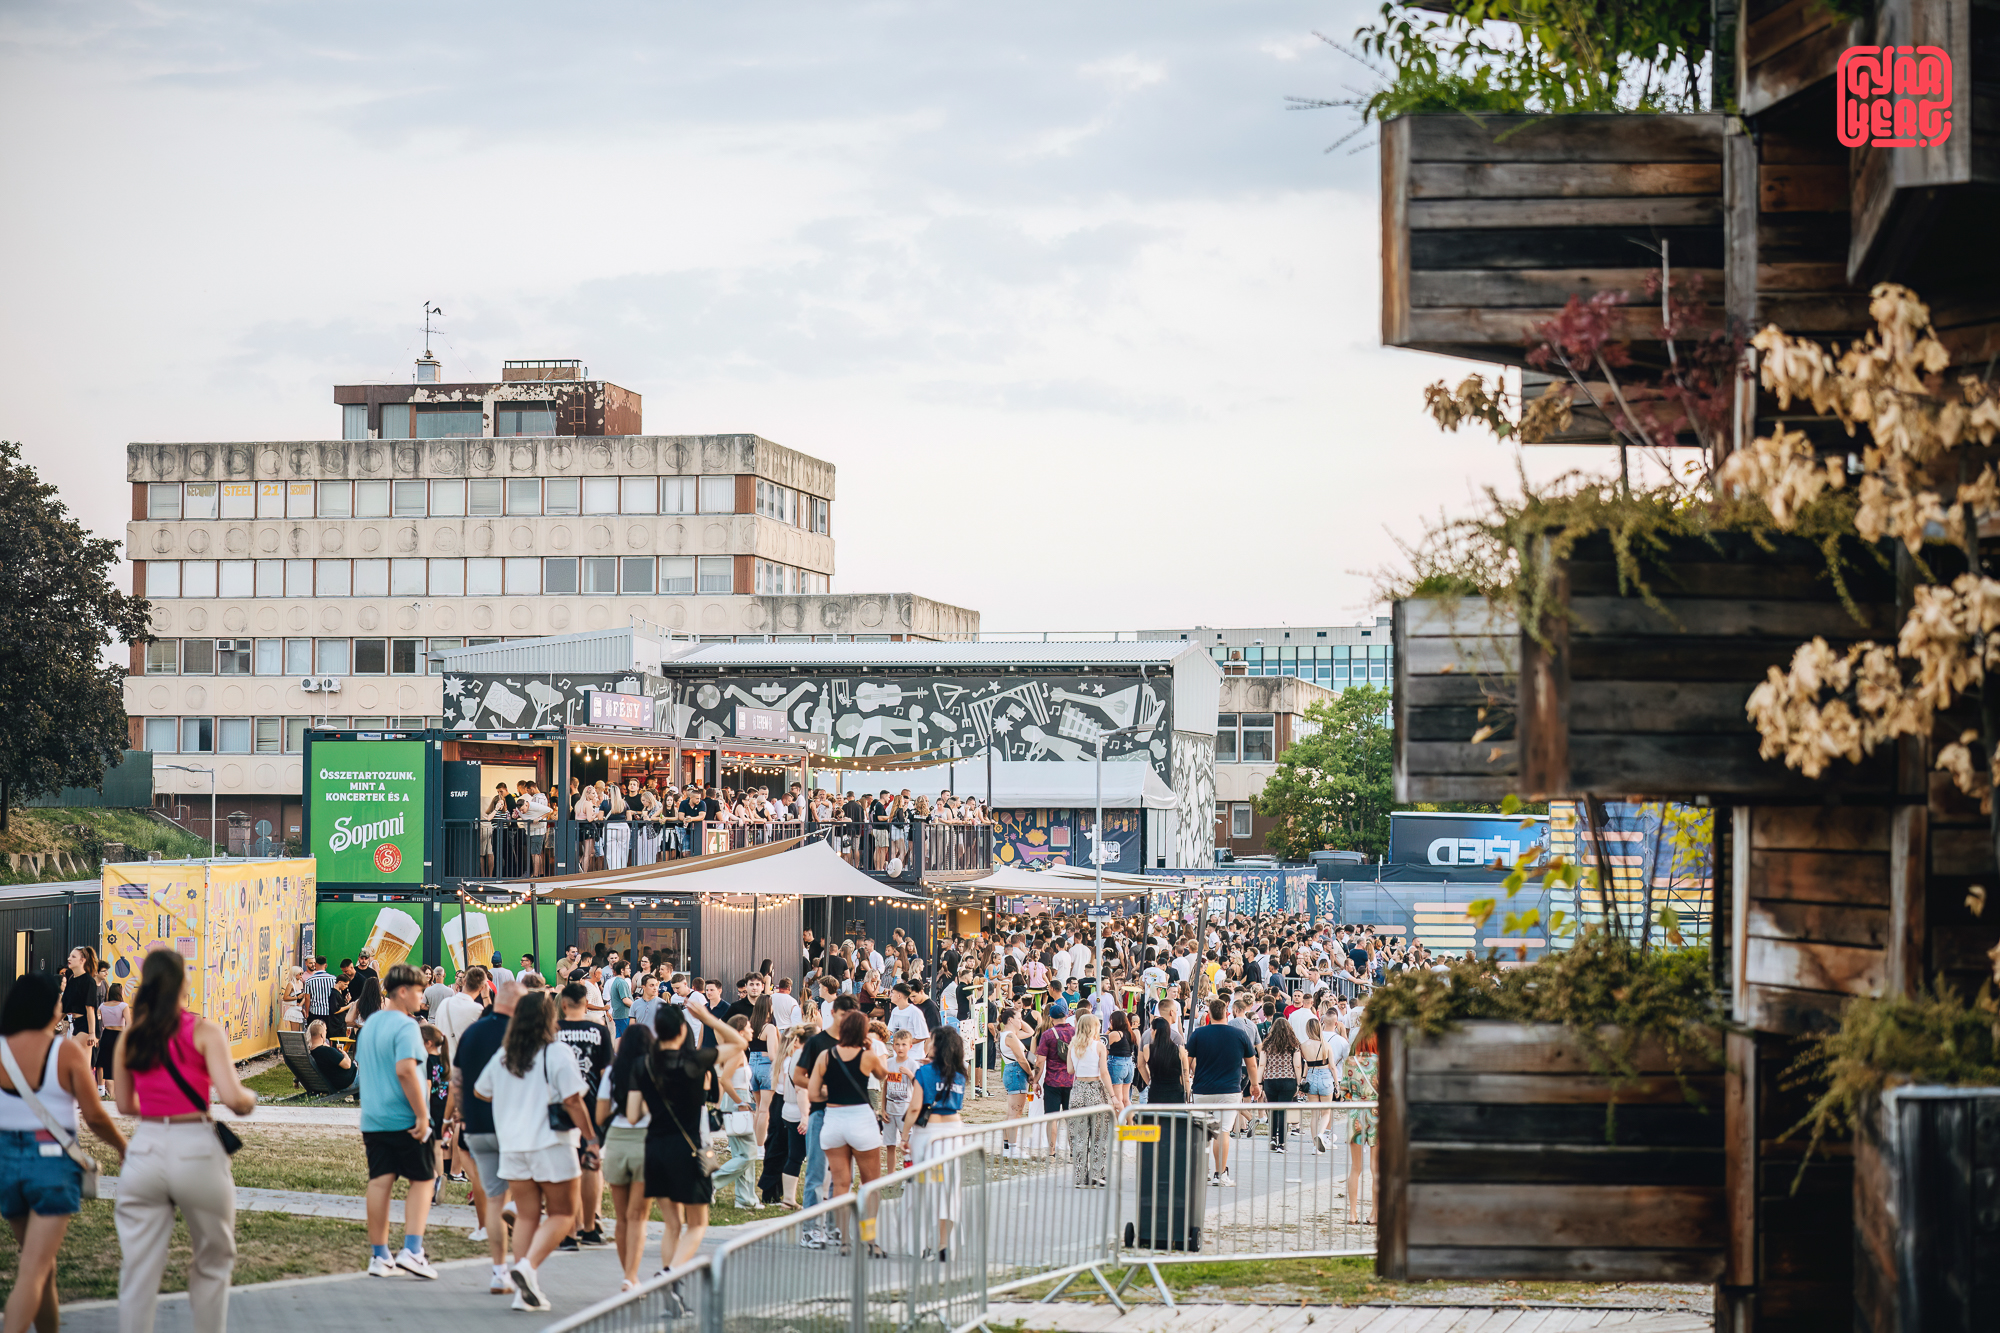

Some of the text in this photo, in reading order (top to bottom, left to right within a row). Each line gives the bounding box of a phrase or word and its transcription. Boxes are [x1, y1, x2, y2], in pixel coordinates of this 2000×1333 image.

[223, 485, 253, 496] STEEL
[290, 484, 312, 496] SECURITY
[612, 698, 640, 719] FÉNY
[319, 768, 416, 781] ÖSSZETARTOZUNK,
[349, 782, 386, 791] MINT A
[325, 791, 410, 802] KONCERTEK ÉS A
[450, 790, 468, 798] STAFF
[328, 811, 405, 854] Soproni
